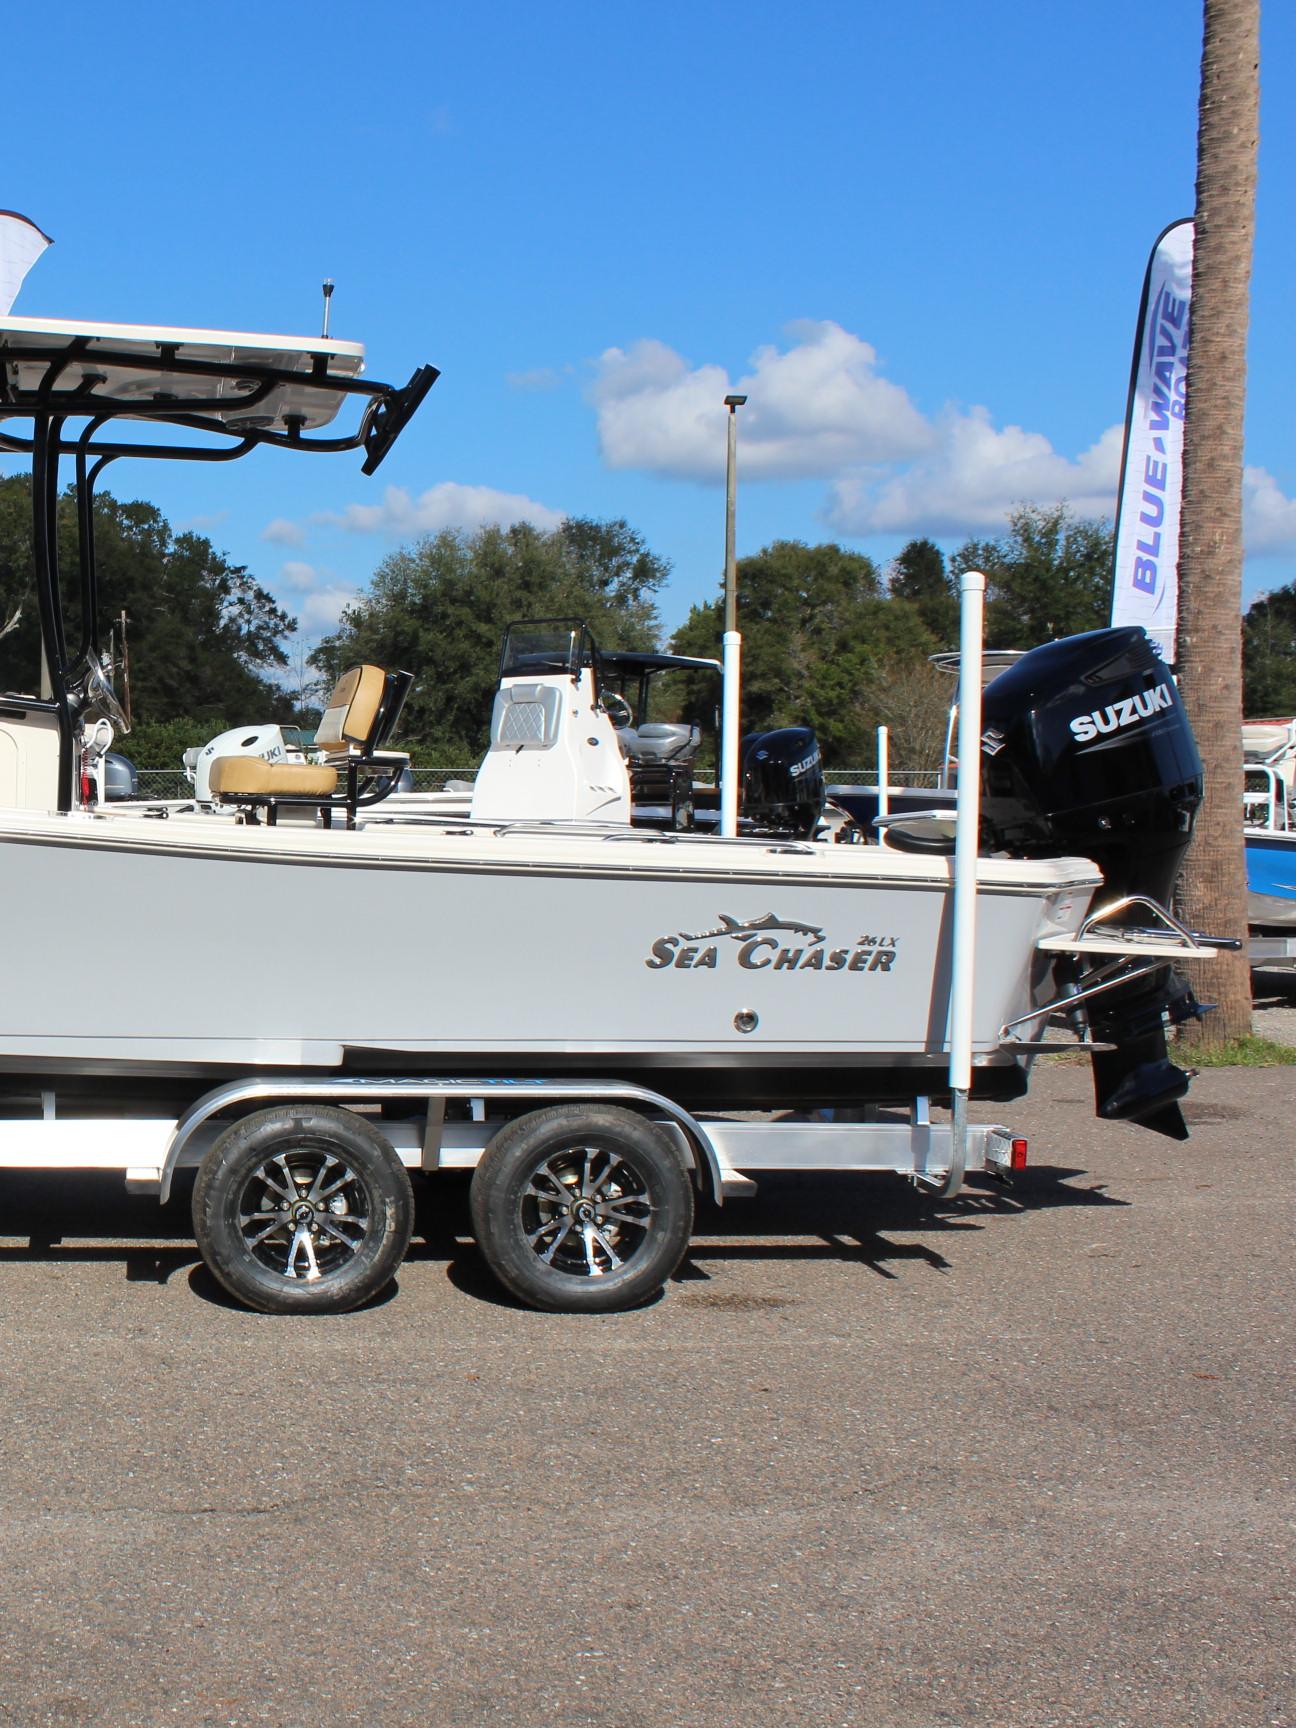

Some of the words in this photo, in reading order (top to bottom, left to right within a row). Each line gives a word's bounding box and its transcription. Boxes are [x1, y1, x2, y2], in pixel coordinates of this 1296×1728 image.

[1149, 290, 1186, 431] WAVE
[1133, 454, 1168, 595] BLUE
[1069, 683, 1173, 742] SUZUKI
[645, 936, 718, 970] SEA
[737, 937, 896, 972] CHASER
